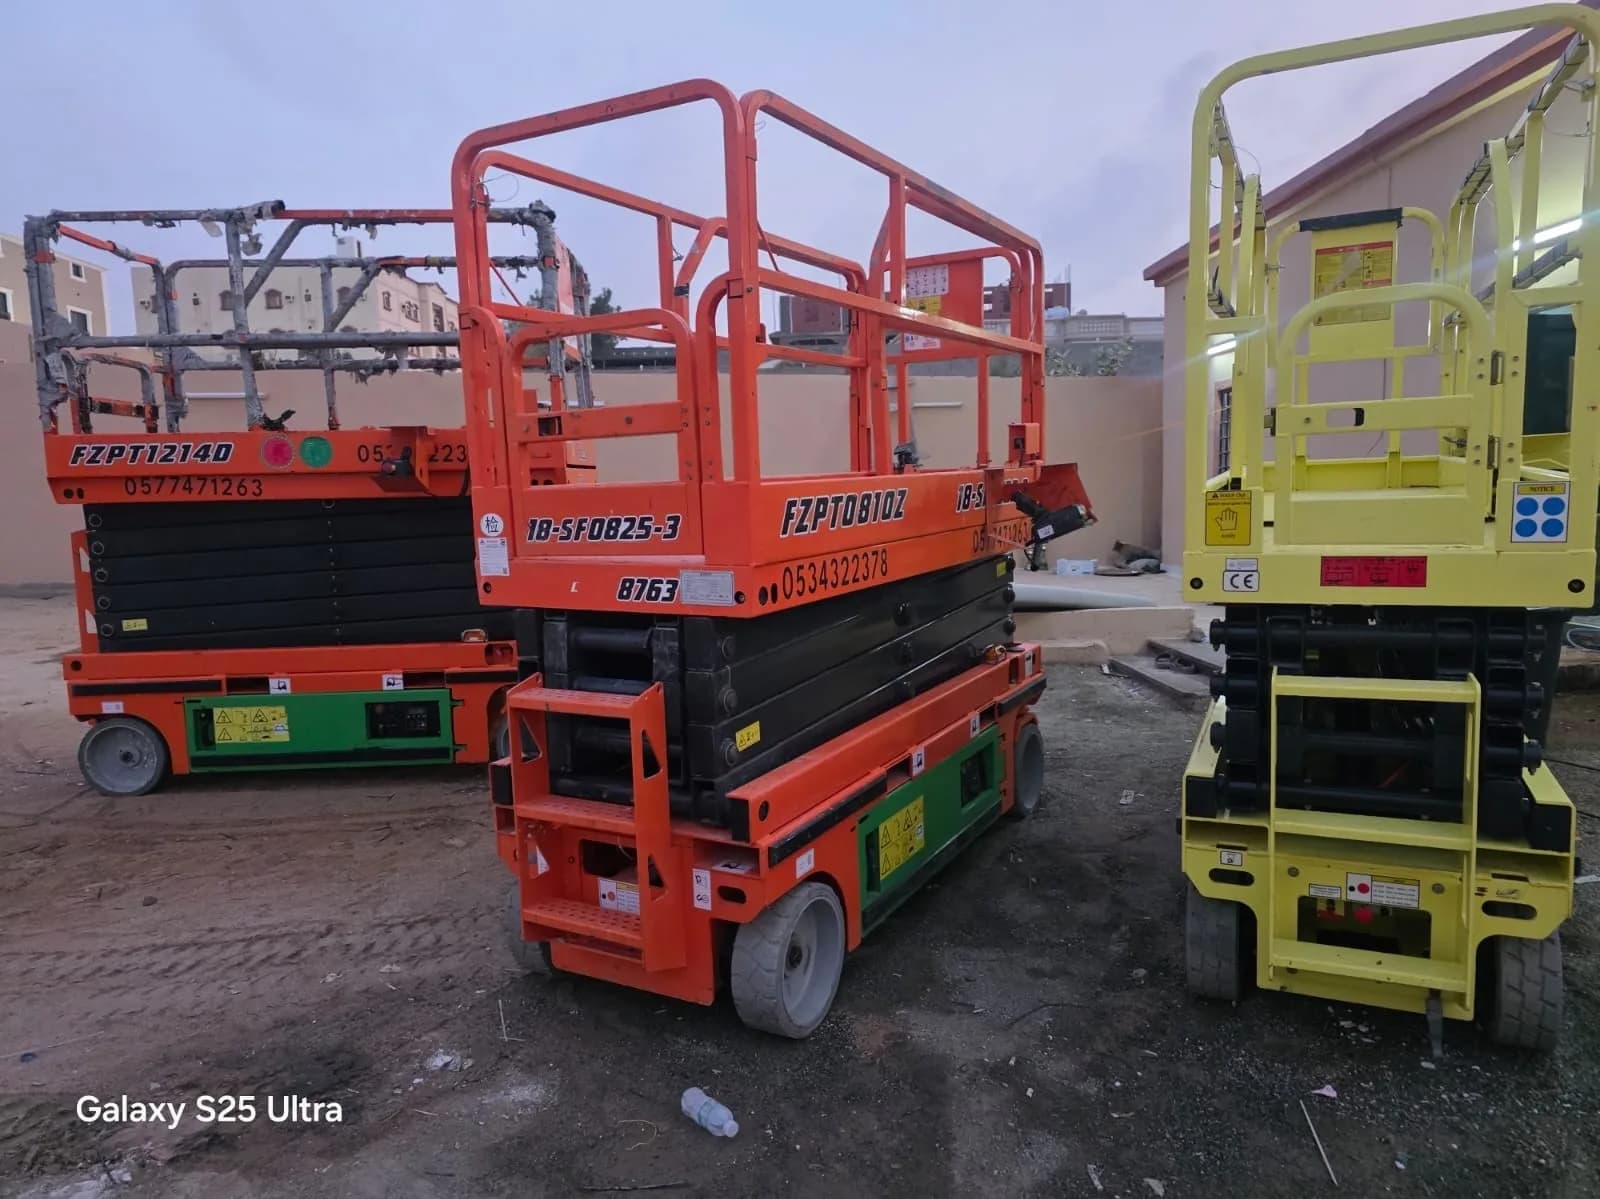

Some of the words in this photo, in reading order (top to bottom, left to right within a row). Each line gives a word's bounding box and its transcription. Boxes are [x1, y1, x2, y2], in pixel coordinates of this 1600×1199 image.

[124, 477, 263, 497] 0577471263
[780, 488, 908, 538] FZPT0810Z
[782, 548, 888, 600] 0534322378
[1230, 573, 1254, 590] CE
[617, 576, 679, 603] 8763
